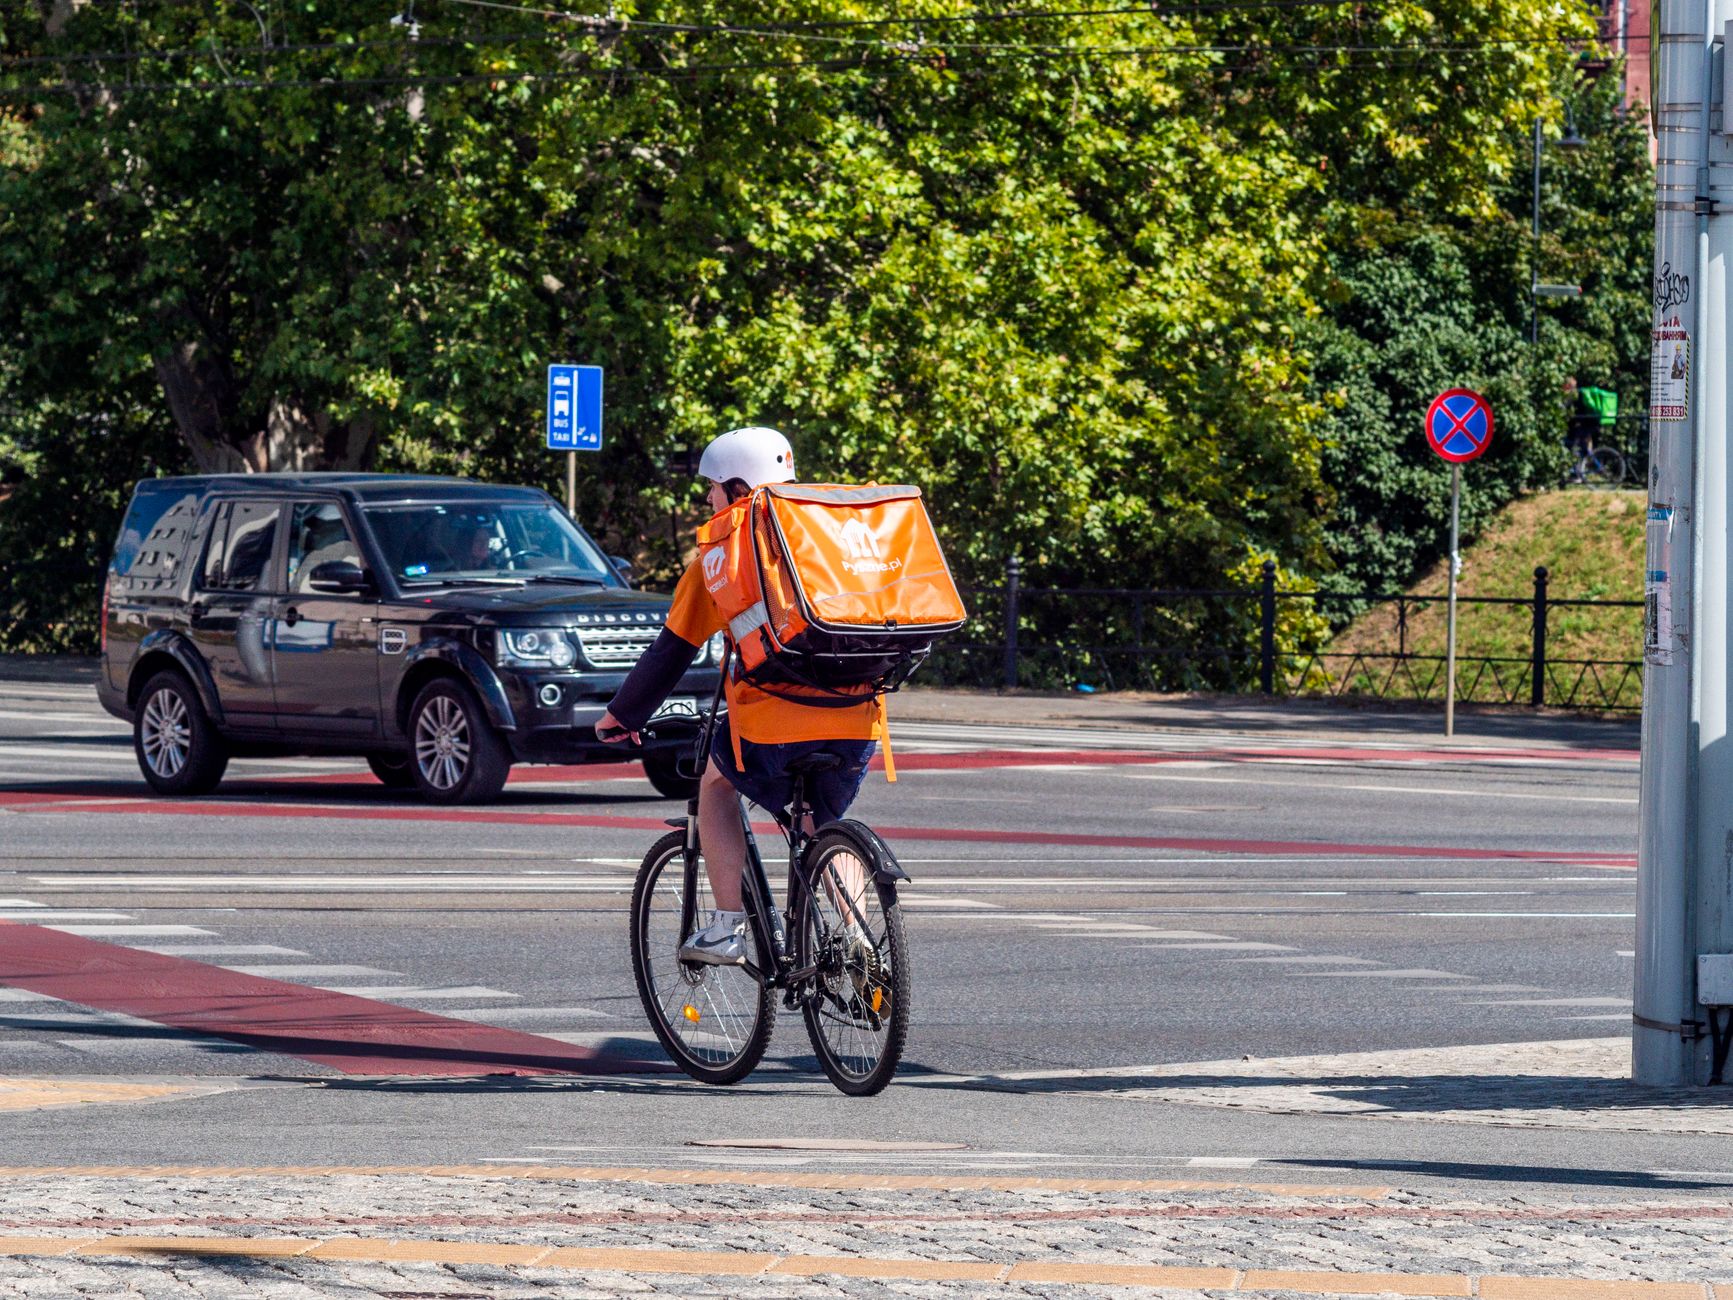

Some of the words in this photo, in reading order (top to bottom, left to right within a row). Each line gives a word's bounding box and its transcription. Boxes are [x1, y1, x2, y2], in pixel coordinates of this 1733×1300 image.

[554, 419, 568, 428] BUS
[841, 557, 902, 576] Pyne.pl
[578, 613, 668, 622] DISCOV
